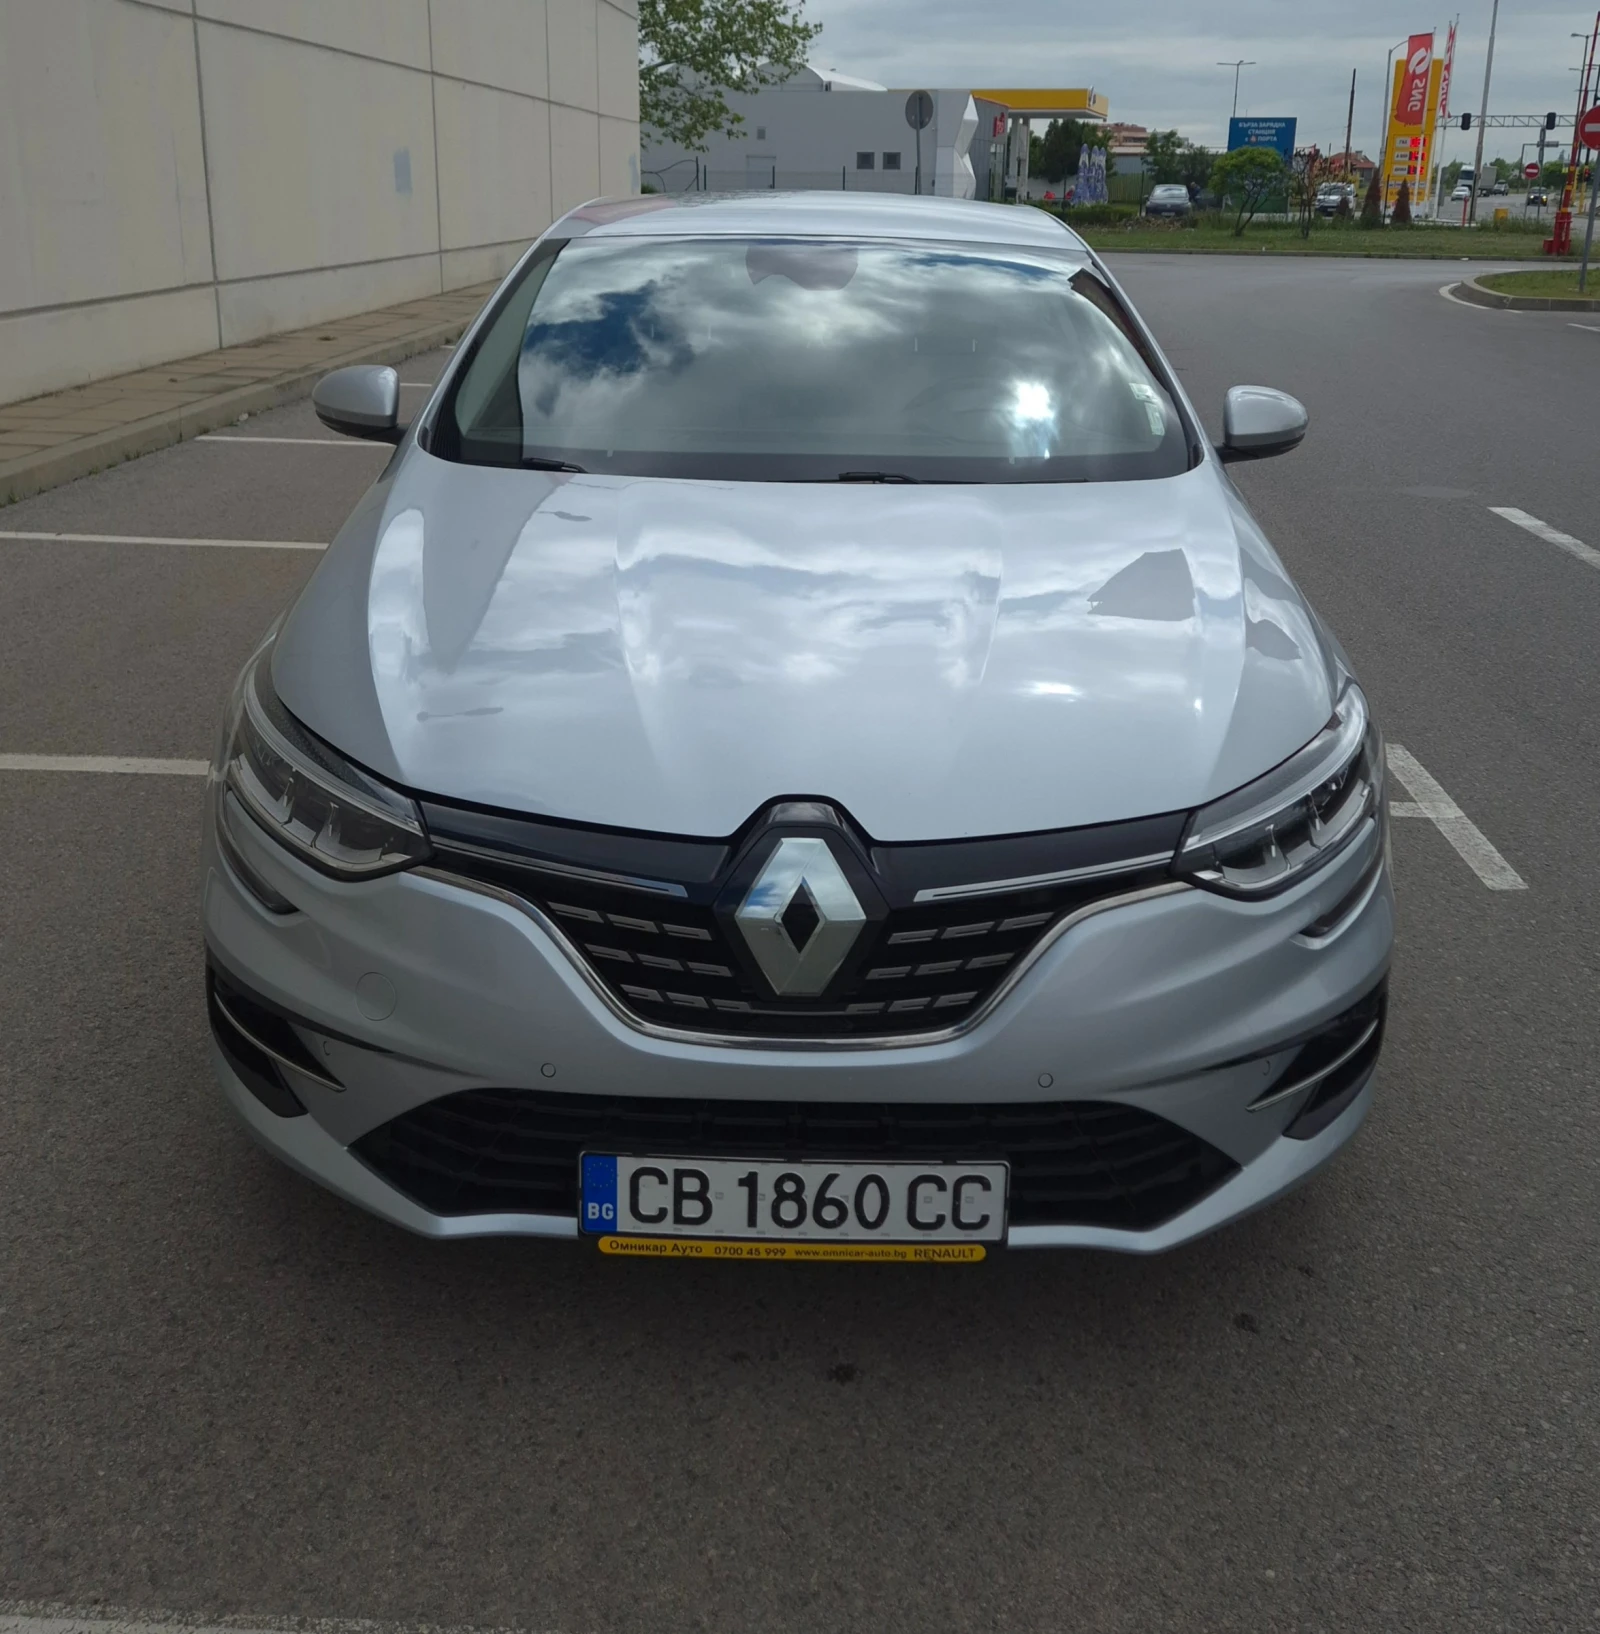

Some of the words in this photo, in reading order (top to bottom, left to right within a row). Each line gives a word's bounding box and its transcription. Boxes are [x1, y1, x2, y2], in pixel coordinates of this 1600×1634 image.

[629, 1166, 713, 1226] CB
[738, 1171, 890, 1230] 1860
[907, 1174, 992, 1231] CC
[587, 1202, 614, 1220] BG
[609, 1240, 667, 1254] Омникар
[671, 1243, 703, 1256] Ауто
[714, 1246, 744, 1257] 0700
[746, 1247, 761, 1257] 45
[765, 1248, 787, 1258] 999
[795, 1248, 907, 1260] www.omnicar-auto.bg
[914, 1247, 976, 1259] RENAULT
